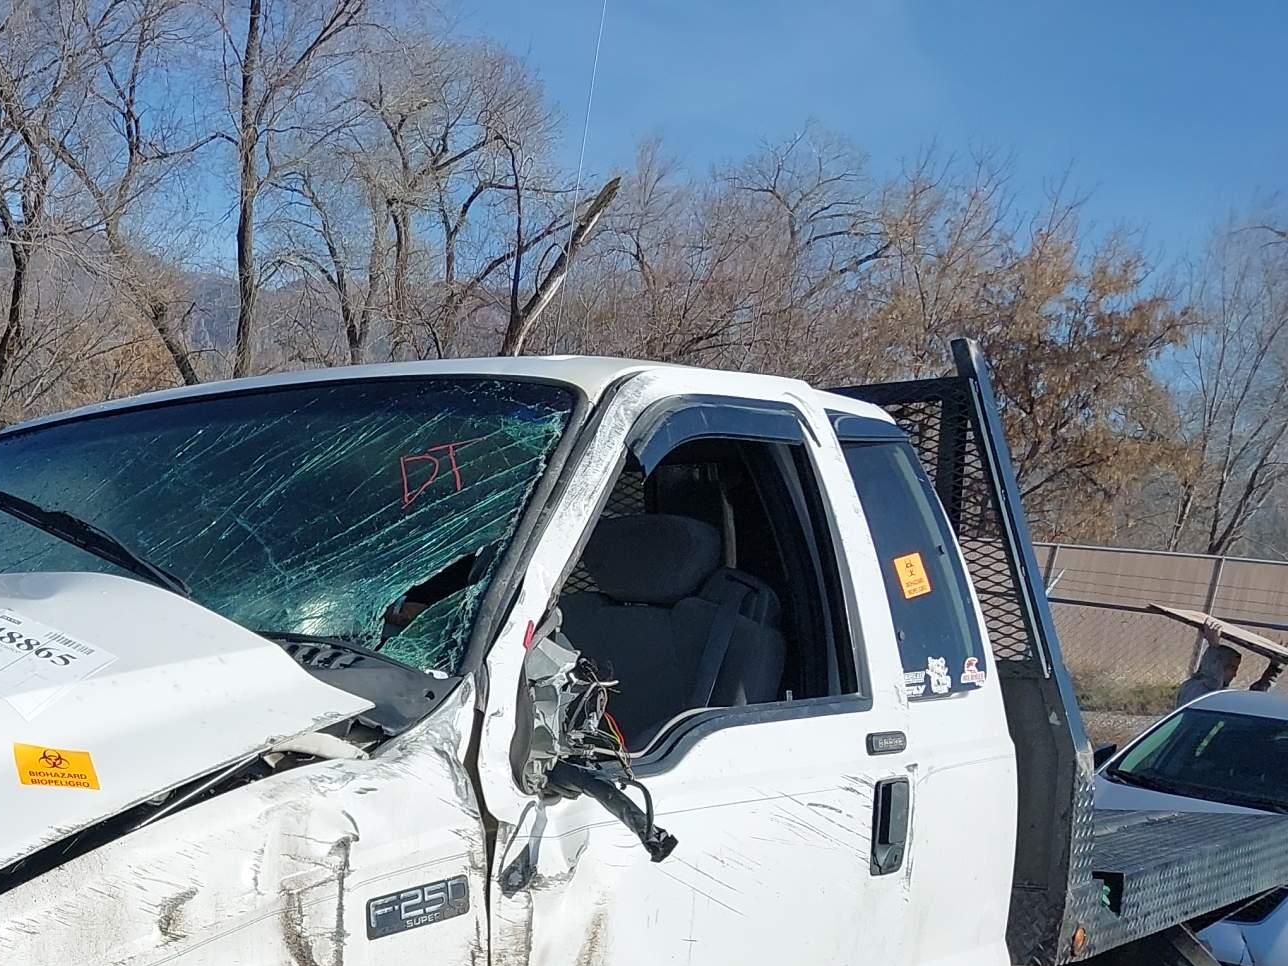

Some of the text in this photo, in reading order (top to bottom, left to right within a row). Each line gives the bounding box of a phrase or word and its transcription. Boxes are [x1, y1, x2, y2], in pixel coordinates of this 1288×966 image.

[400, 438, 484, 509] DT
[28, 770, 88, 780] BIOHAZARD
[30, 778, 91, 788] BIOPELIGRO
